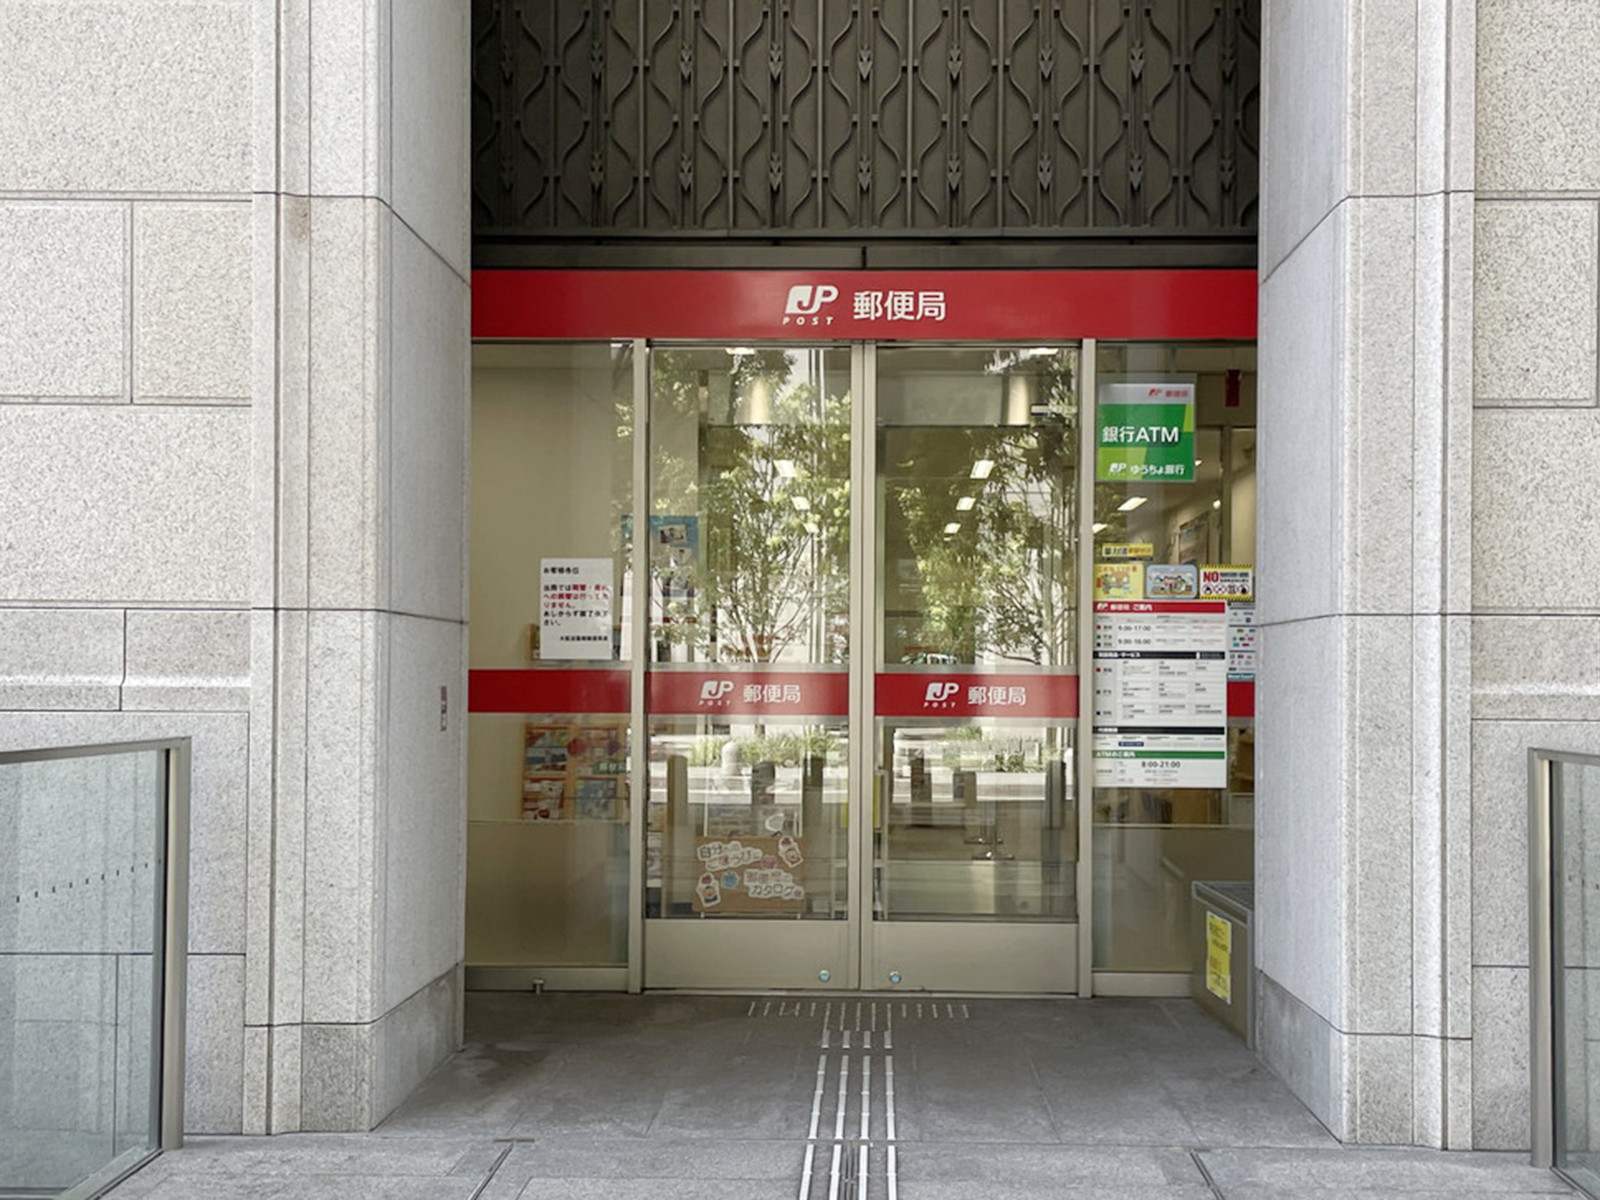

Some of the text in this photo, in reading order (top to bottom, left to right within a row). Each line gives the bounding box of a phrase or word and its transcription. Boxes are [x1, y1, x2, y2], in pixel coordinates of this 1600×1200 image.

[785, 285, 946, 321] JP 郵便局
[782, 316, 834, 326] POST
[1102, 426, 1179, 443] 銀行ATM
[1130, 464, 1185, 476] ゆうちょ銀行
[1203, 571, 1219, 583] NO
[700, 680, 801, 703] JP 郵便局
[925, 682, 1026, 706] JP 郵便局
